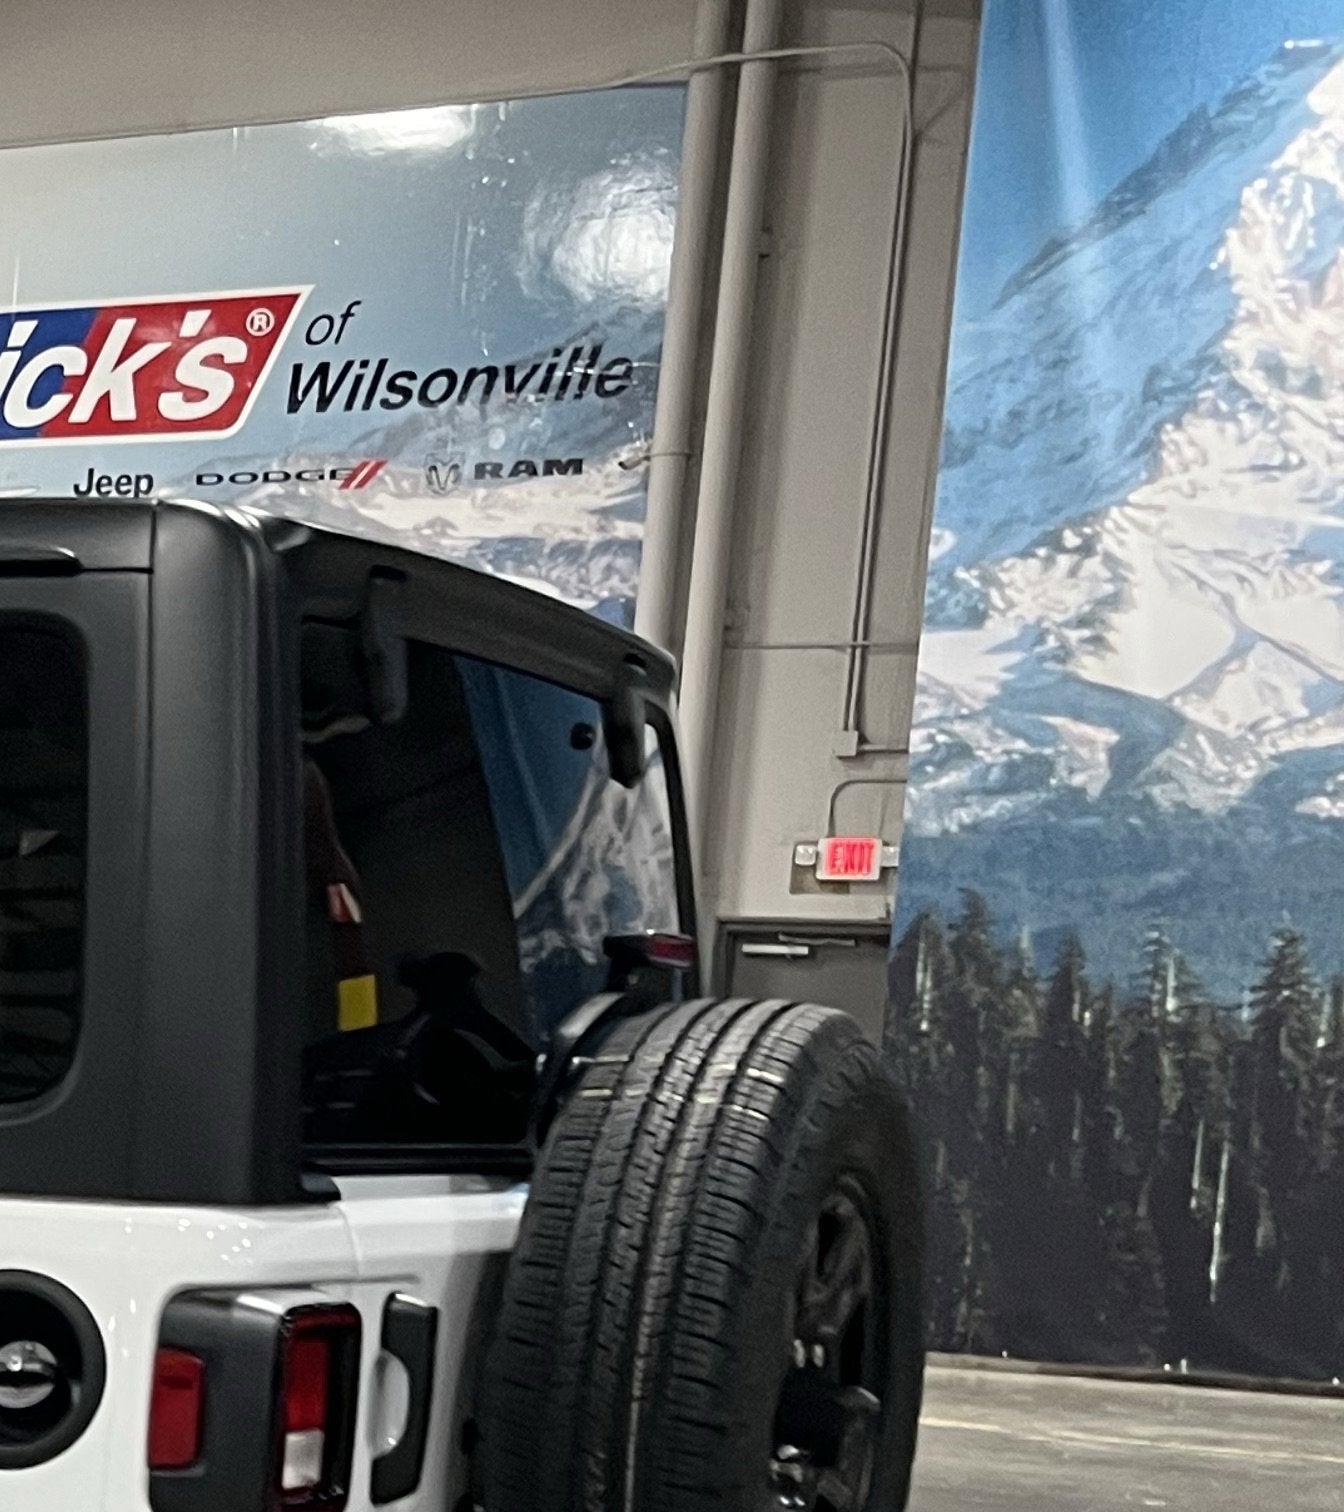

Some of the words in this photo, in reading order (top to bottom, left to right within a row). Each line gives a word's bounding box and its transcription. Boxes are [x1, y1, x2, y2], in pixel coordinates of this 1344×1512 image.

[305, 300, 361, 345] of
[286, 342, 634, 414] Wilsonville
[73, 467, 154, 498] Jeep
[196, 466, 358, 486] DODGE
[474, 458, 584, 480] RAM
[829, 841, 874, 873] EXIT
